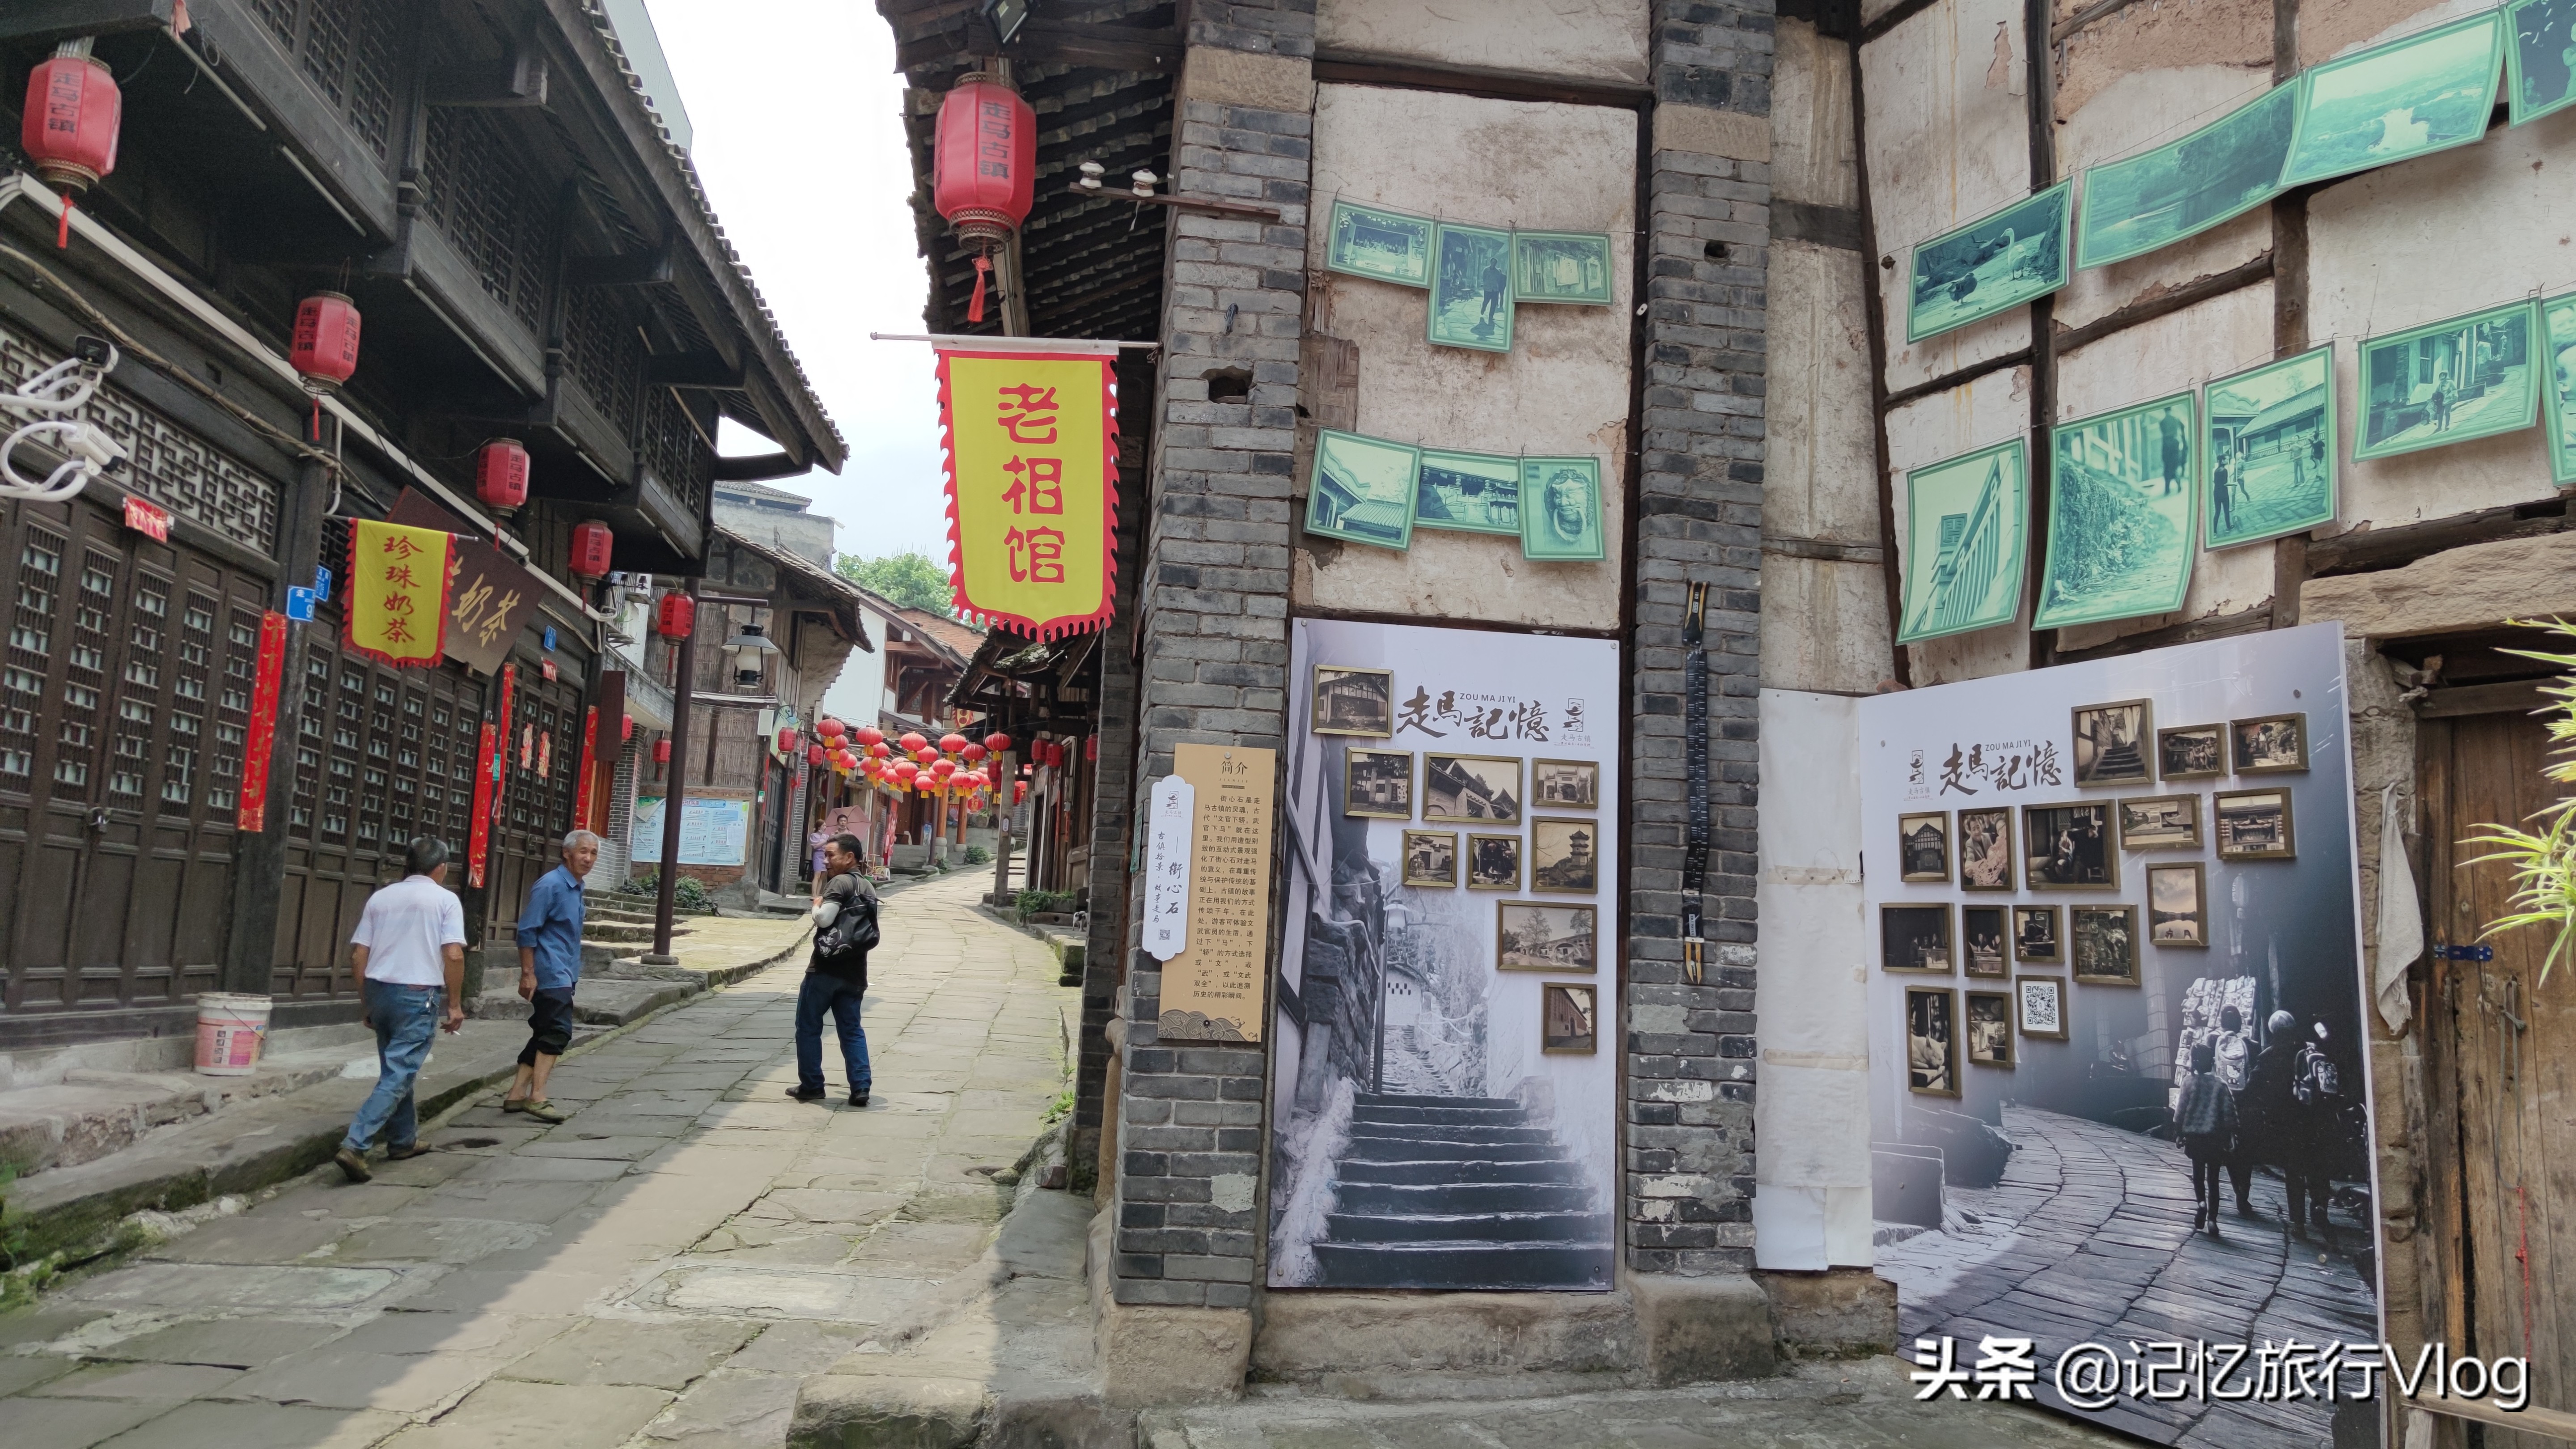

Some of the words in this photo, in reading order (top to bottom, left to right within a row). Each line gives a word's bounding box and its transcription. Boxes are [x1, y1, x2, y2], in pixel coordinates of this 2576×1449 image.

[49, 72, 80, 133] 走马古镇
[979, 102, 1011, 179] 走马古镇
[343, 317, 358, 363] 走马古镇
[509, 454, 523, 491] 走马古镇
[997, 382, 1065, 583] 老相馆
[381, 535, 424, 644] 珍珠奶茶
[1460, 693, 1479, 701] ZOU
[1561, 733, 1591, 742] 走马古镇
[1985, 742, 2000, 751] ZOU
[2002, 741, 2014, 750] MA
[2023, 739, 2031, 747] YI
[1221, 761, 1248, 775] 简介
[1220, 795, 1260, 804] 街心石是走
[1204, 805, 1260, 814] 马古镇的灵魂，古
[1202, 835, 1258, 845] 里。我们用造型别
[1201, 845, 1258, 855] 致的互动式景观强
[1201, 855, 1257, 865] 化了街心石对走马
[1200, 865, 1257, 875] 的意义，在尊重传
[1199, 876, 1256, 886] 统与保护传统的基
[1199, 886, 1255, 896] 础上，古镇的故事
[1199, 897, 1255, 906] 正在用我们的方式
[1198, 907, 1254, 916] 传颂千年。在此
[1197, 918, 1254, 927] 处，游客可体验文
[1197, 928, 1253, 937] 武官员的生活，通
[1193, 991, 1246, 1000] 历史的精彩瞬间。
